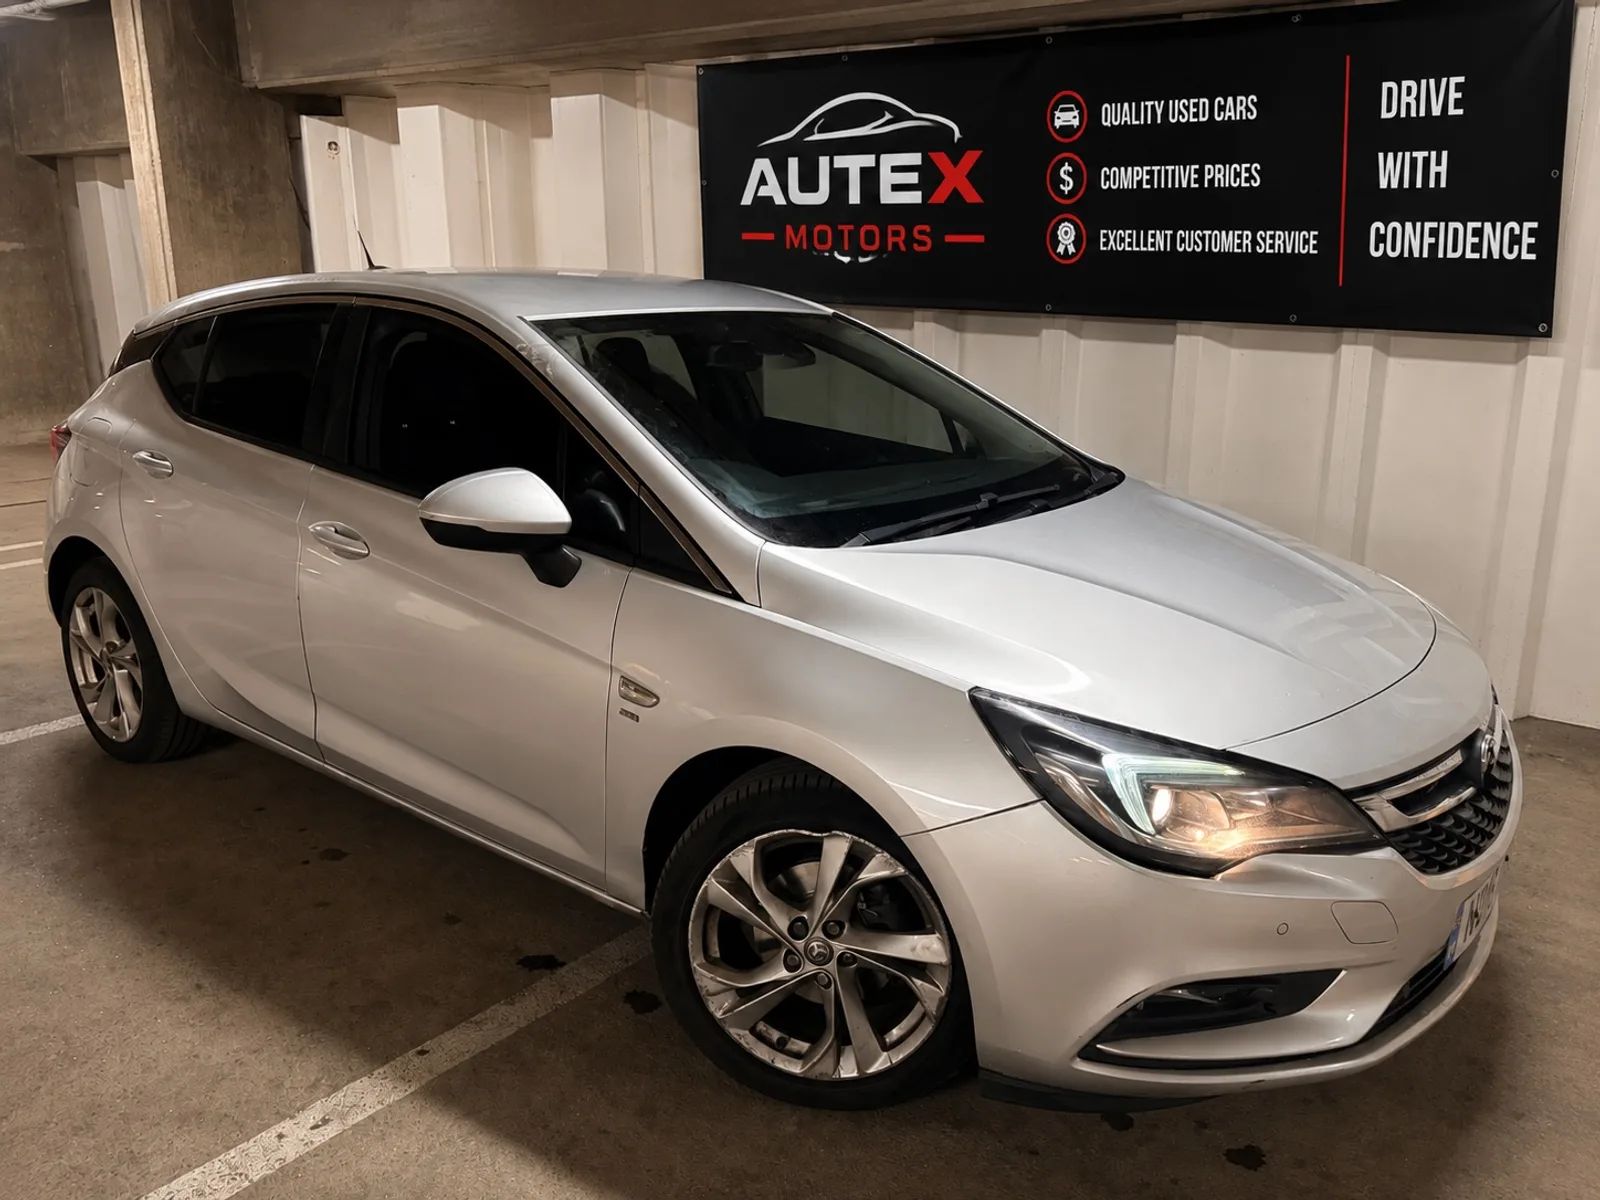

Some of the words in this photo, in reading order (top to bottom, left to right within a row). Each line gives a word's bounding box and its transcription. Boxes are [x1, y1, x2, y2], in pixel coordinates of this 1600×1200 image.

[1102, 100, 1164, 127] QUALITY
[1169, 98, 1209, 123] USED
[1214, 95, 1257, 121] CARS
[1381, 76, 1465, 118] DRIVE
[741, 150, 982, 205] AUTEX
[1101, 165, 1199, 189] COMPETITIVE
[1205, 163, 1260, 187] PRICES
[1378, 150, 1448, 188] WITH
[786, 225, 931, 250] MOTORS
[1100, 230, 1173, 251] EXCELLENT
[1177, 230, 1251, 252] CUSTOMER
[1256, 231, 1318, 254] SERVICE
[1370, 221, 1538, 260] CONFIDENCE
